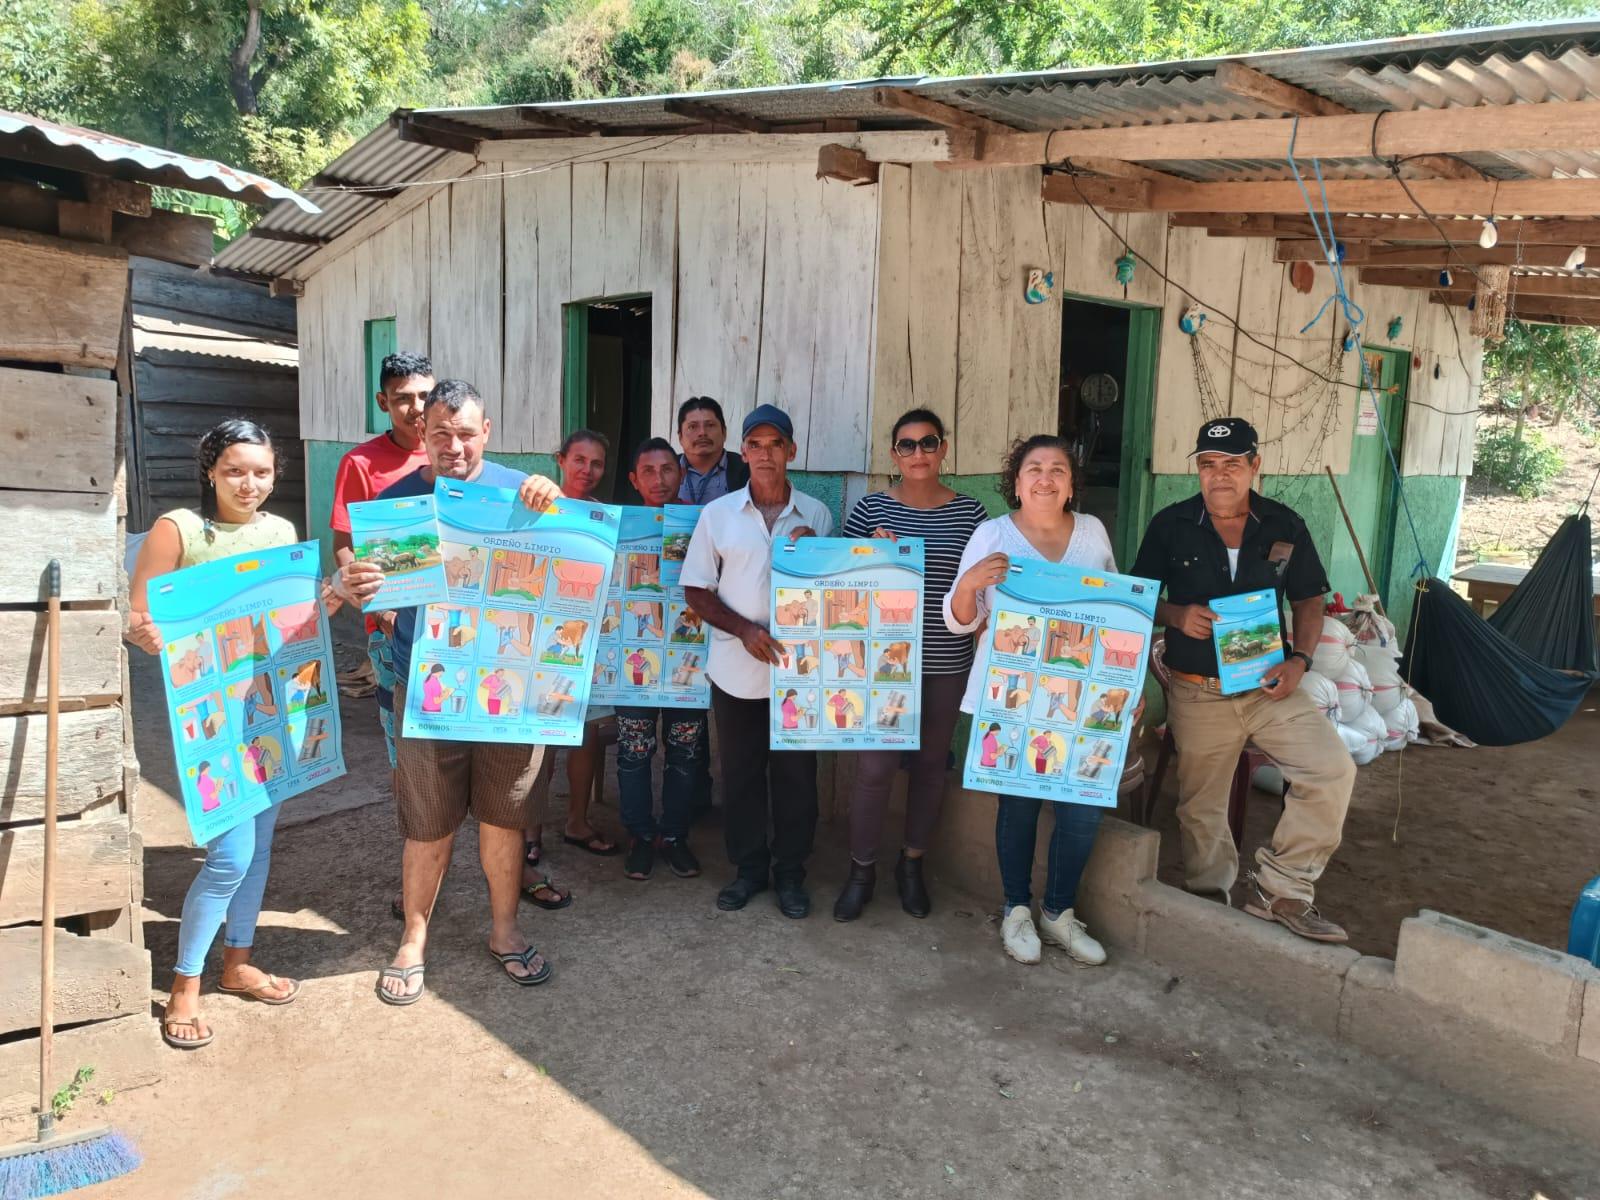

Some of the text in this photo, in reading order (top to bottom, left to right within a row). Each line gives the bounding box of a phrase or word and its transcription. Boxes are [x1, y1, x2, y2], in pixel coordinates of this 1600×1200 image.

[483, 536, 561, 554] ORDEÑO LIMPIO
[814, 579, 846, 587] ORDEÑO
[1040, 606, 1107, 624] ORDEÑO LIMPIO
